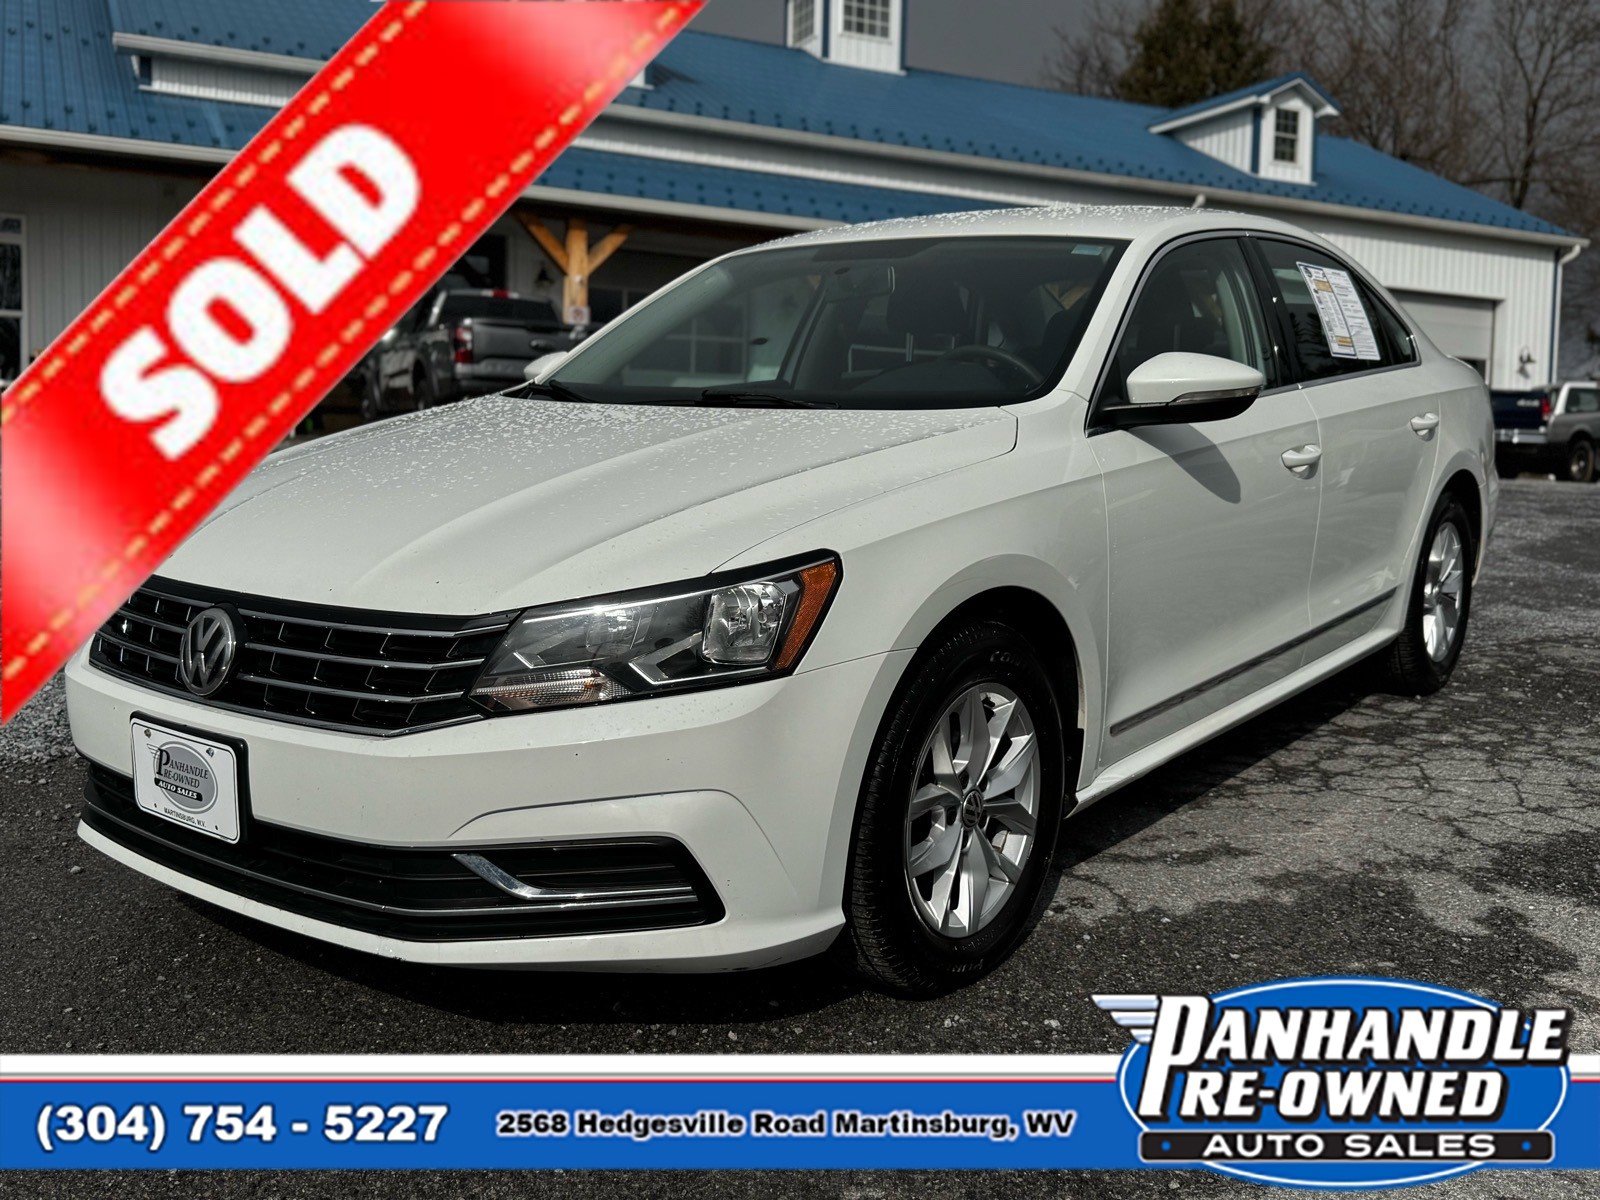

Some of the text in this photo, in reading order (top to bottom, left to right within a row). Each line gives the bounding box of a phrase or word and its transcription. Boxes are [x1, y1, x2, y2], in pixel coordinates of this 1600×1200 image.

[156, 748, 208, 779] PANHANDLE
[159, 780, 198, 799] AUTO SALES
